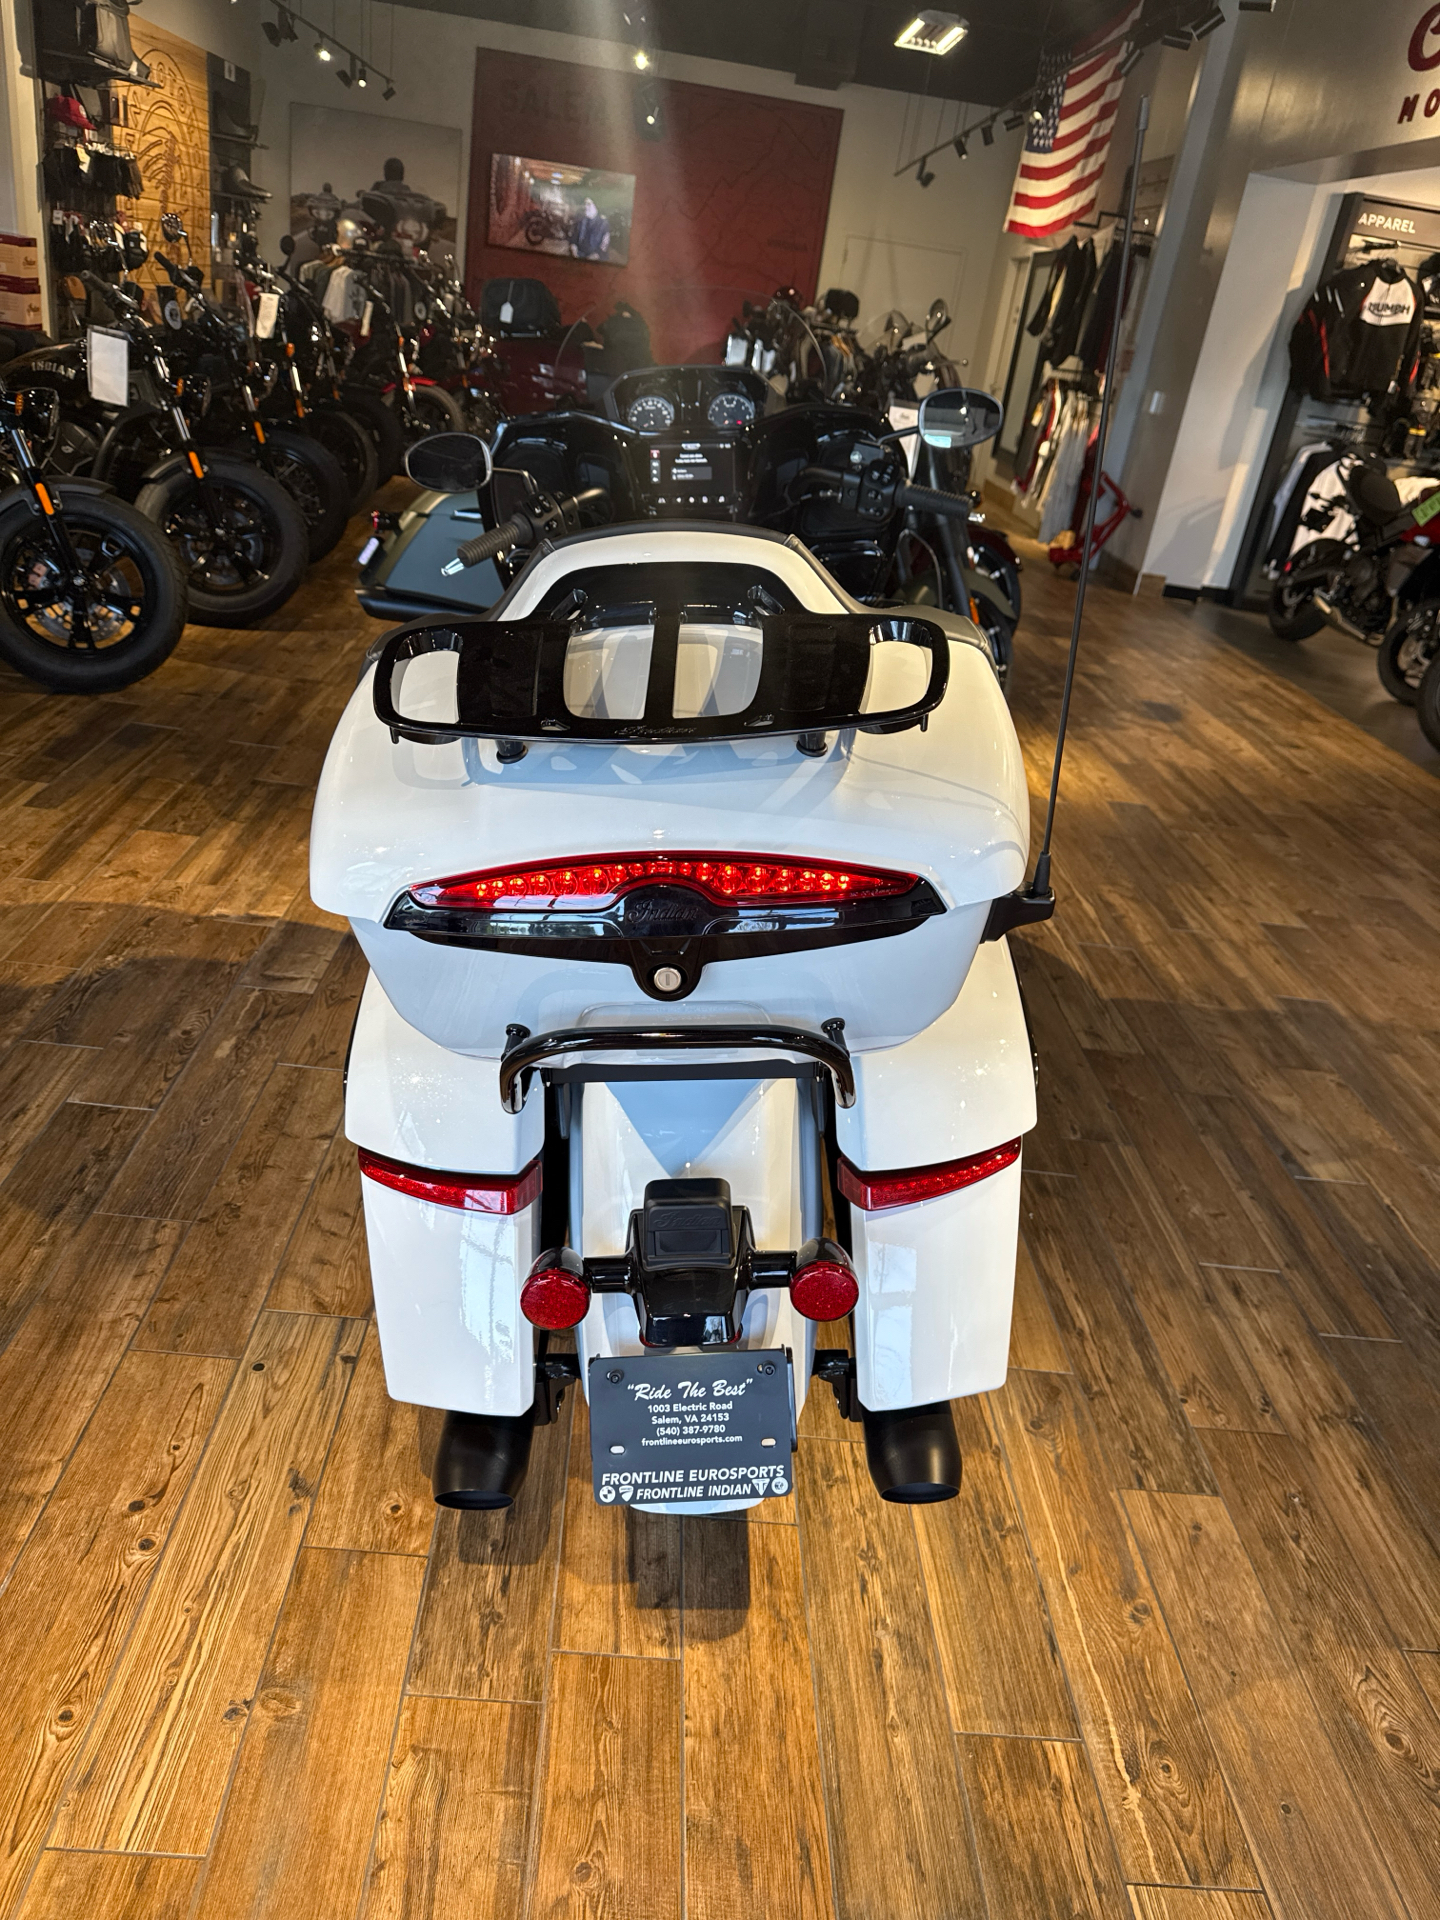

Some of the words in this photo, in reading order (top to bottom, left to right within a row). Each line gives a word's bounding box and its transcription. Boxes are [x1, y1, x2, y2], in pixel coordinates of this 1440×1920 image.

[1358, 212, 1416, 234] APPAREL
[30, 360, 77, 380] INDIAN
[628, 898, 699, 924] Indian
[653, 1211, 722, 1228] Indian
[677, 1381, 707, 1399] The
[648, 1404, 671, 1413] 1003
[673, 1403, 707, 1412] Electric
[709, 1401, 733, 1410] Road
[651, 1415, 682, 1425] Salem,
[684, 1414, 699, 1423] VA
[700, 1413, 730, 1422] 24153
[656, 1426, 680, 1437] (540)
[682, 1424, 726, 1434] 387-9780
[641, 1435, 743, 1447] frontlineeurosports.com
[602, 1470, 685, 1486] FRONTLINE
[689, 1465, 785, 1482] EUROSPORTS
[636, 1486, 704, 1500] FRONTLINE
[708, 1483, 752, 1497] INDIAN
